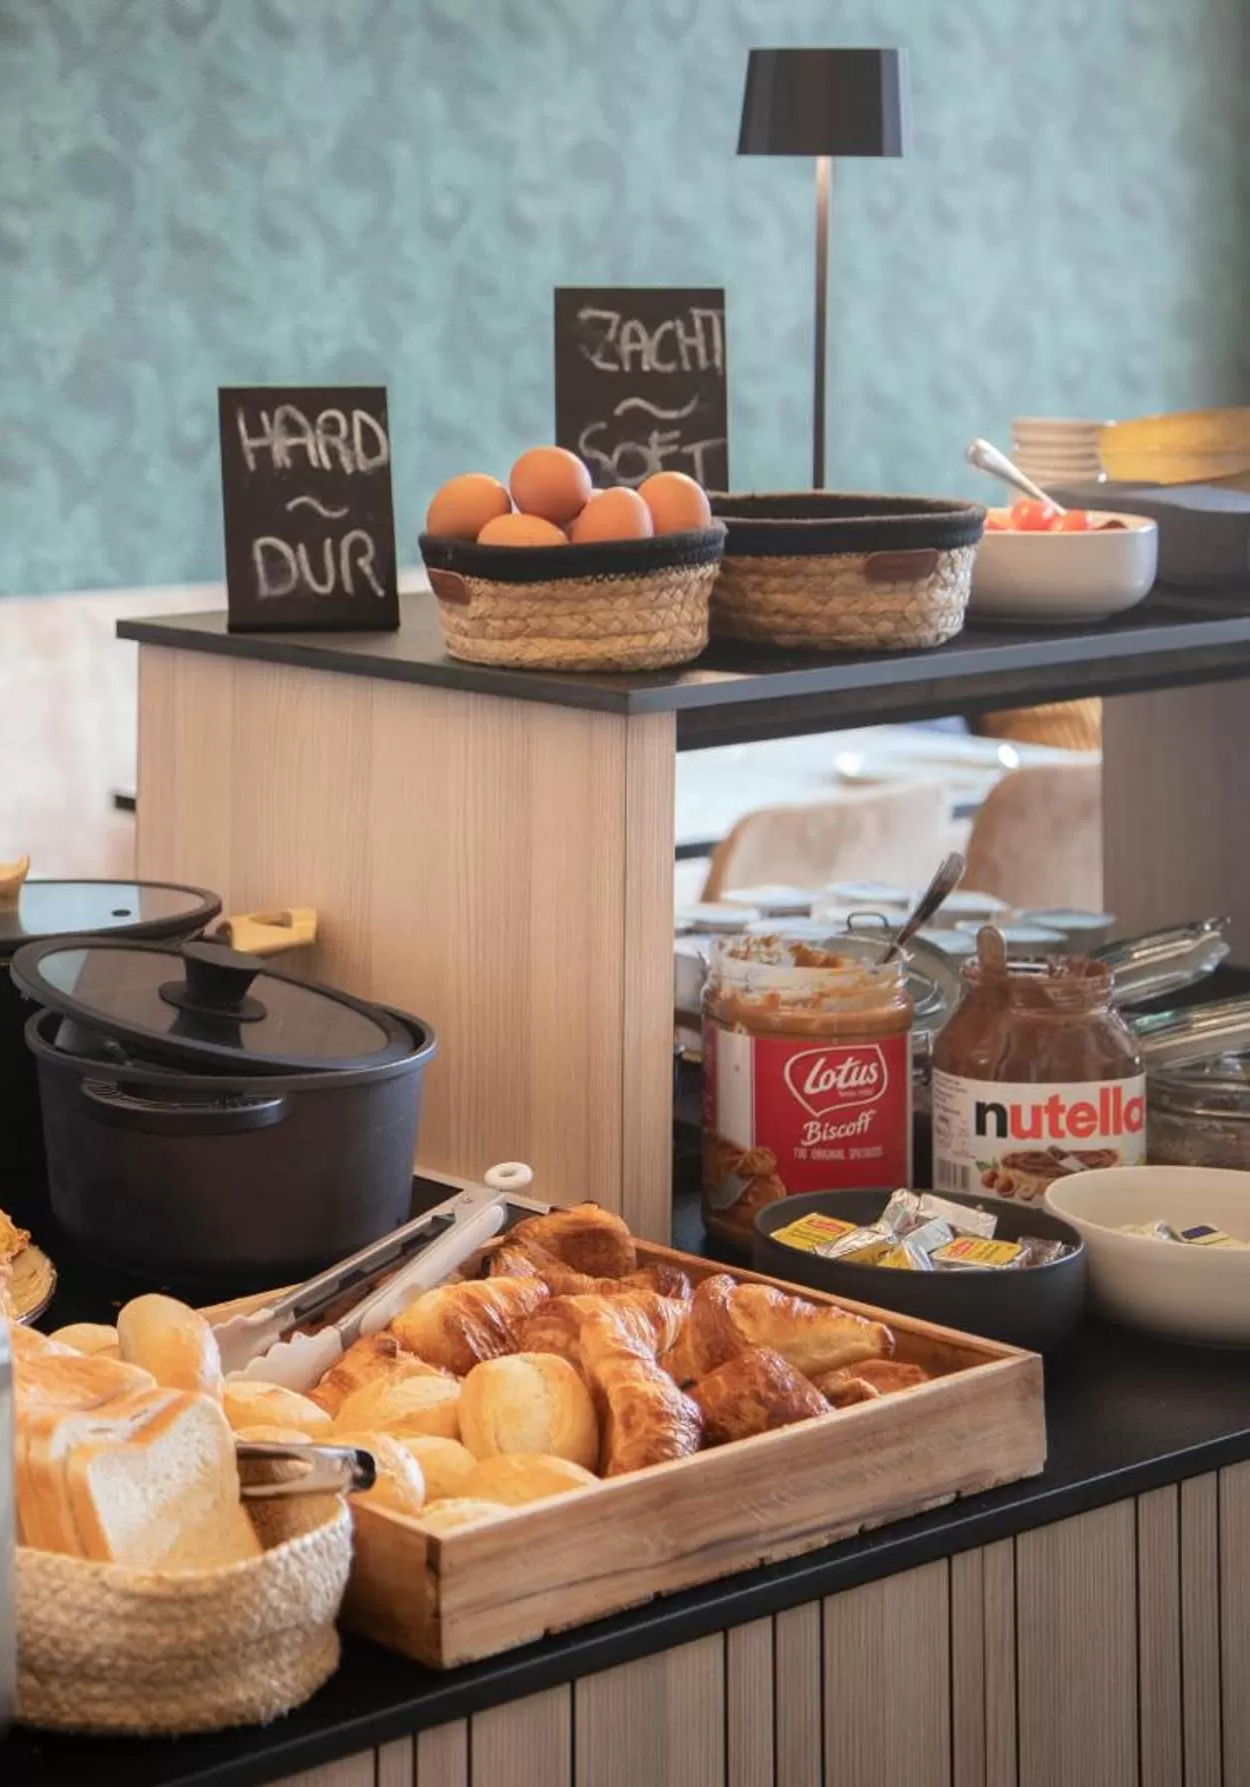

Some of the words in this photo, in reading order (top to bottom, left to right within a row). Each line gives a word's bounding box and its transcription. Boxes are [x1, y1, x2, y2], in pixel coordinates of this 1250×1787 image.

[577, 306, 724, 375] ZACHT
[237, 403, 389, 475] HARD
[578, 421, 727, 488] SOFT
[252, 529, 386, 598] DUR
[803, 1056, 879, 1095] Lotus
[800, 1109, 877, 1146] Biscoff
[975, 1085, 1144, 1140] nutella
